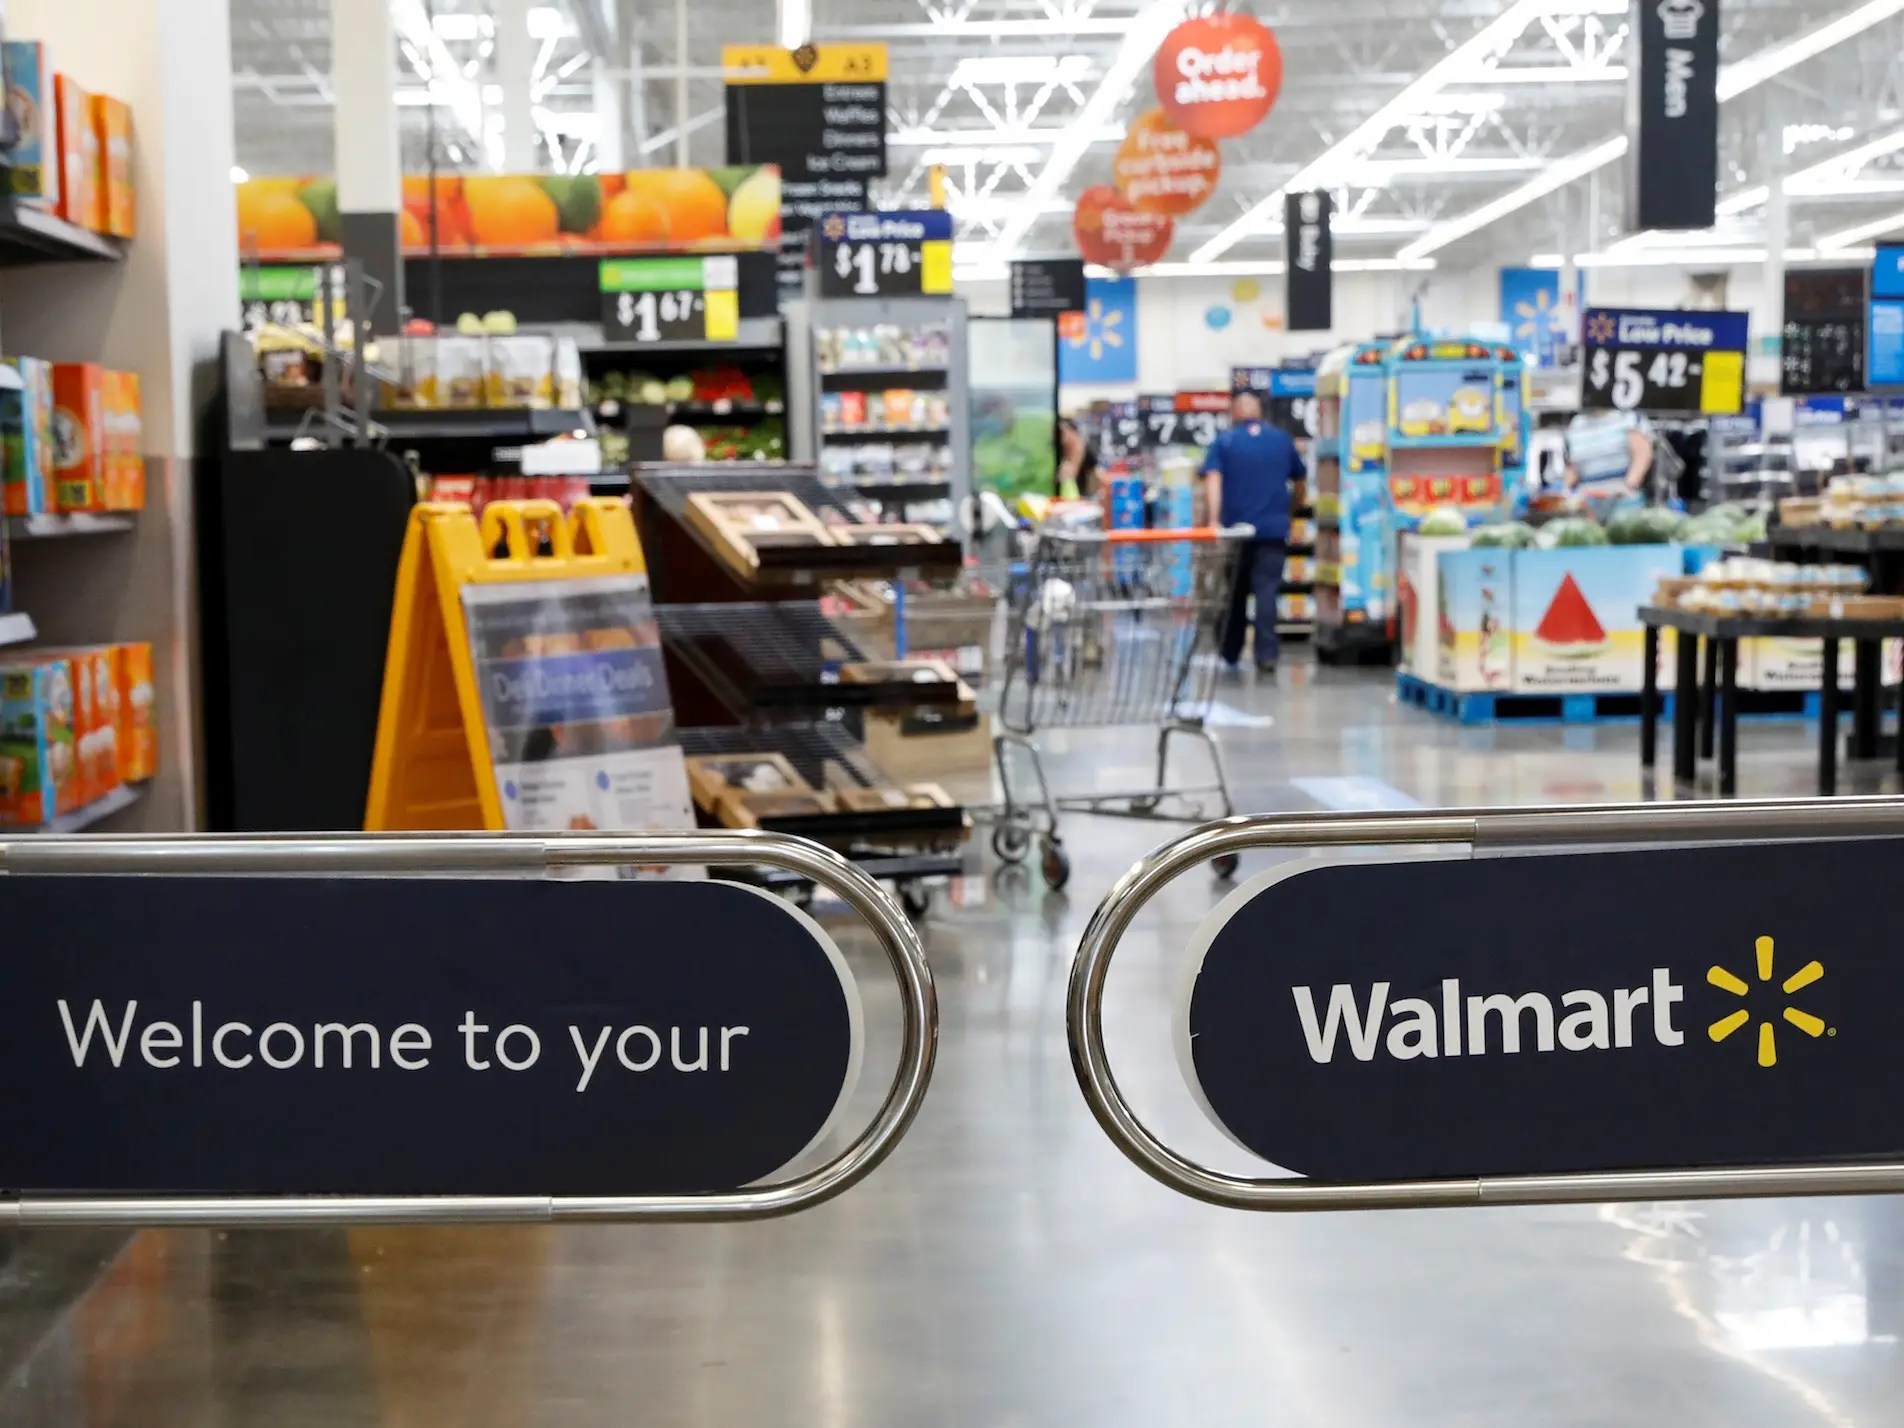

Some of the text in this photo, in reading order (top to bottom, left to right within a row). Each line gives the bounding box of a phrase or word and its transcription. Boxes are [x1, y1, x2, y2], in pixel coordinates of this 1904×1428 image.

[1176, 47, 1262, 77] Order
[1174, 71, 1266, 104] ahead.
[1664, 48, 1695, 118] Men
[1137, 129, 1189, 150] Free
[1661, 322, 1714, 346] Price
[1292, 967, 1684, 1064] Walmart
[57, 999, 749, 1092] Welcome to your
